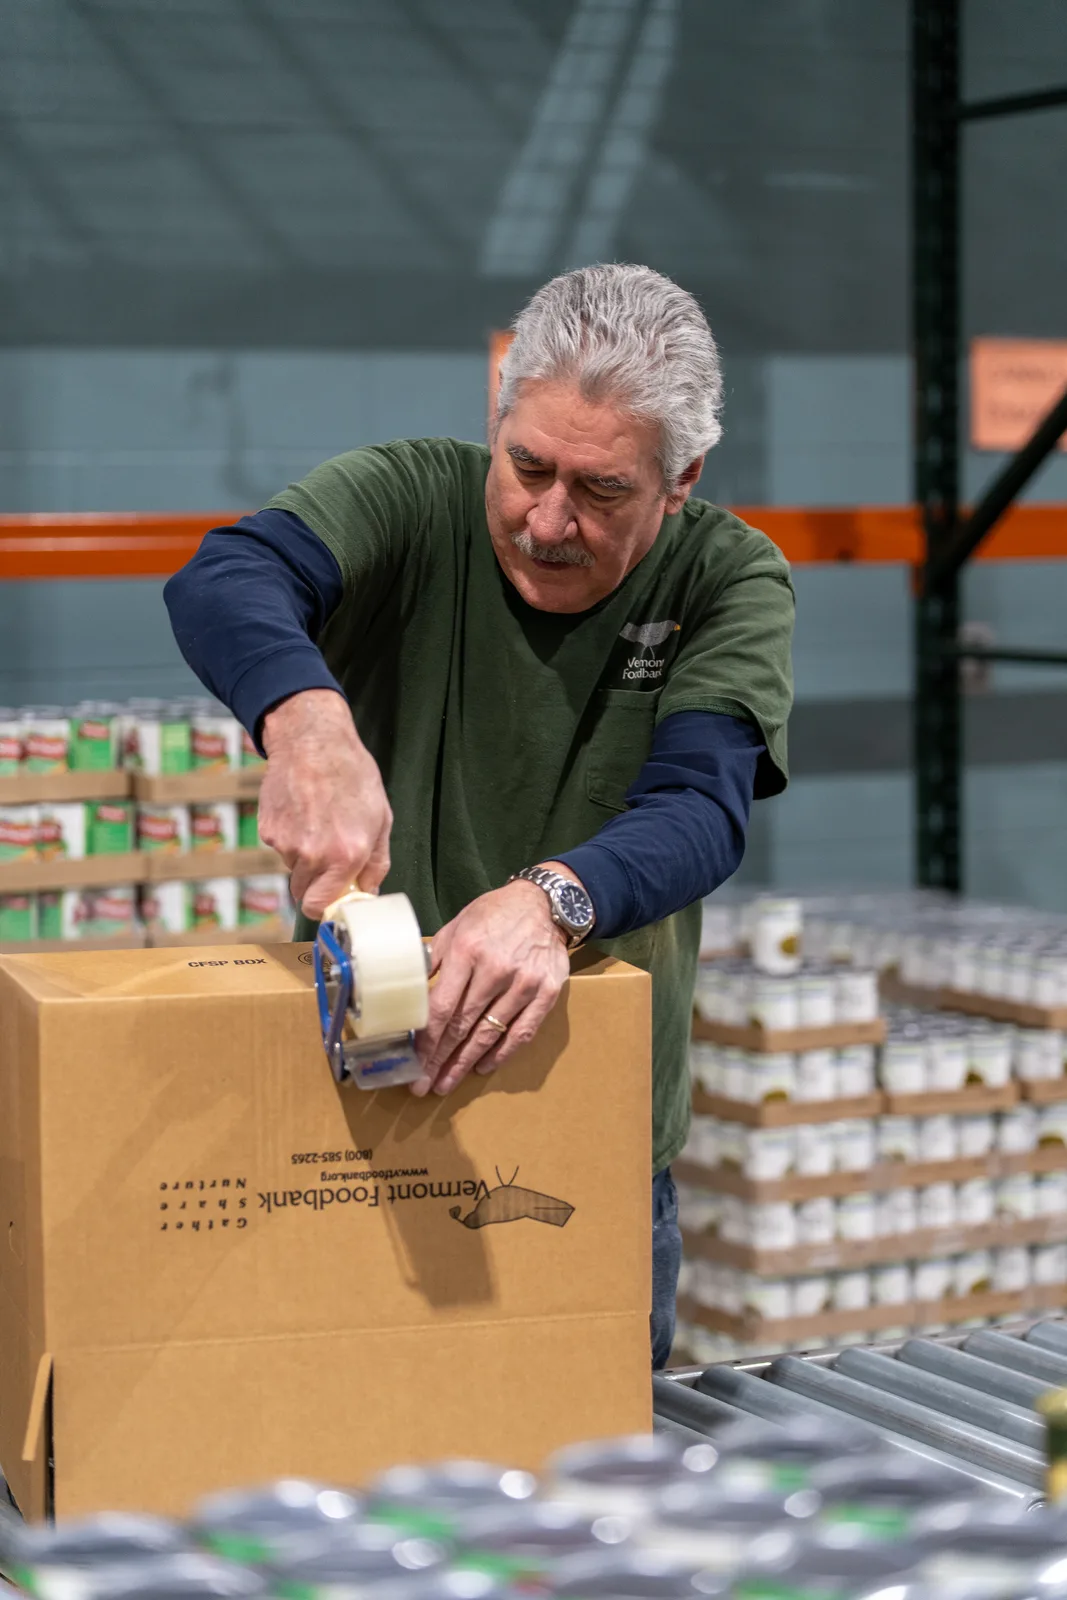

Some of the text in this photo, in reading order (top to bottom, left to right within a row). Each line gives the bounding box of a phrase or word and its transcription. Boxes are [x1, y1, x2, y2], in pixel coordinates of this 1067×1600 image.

[188, 958, 268, 968] CFSP BOX
[291, 1148, 373, 1164] (800) 585-2265
[320, 1167, 428, 1181] www.vtfoodbank.org
[159, 1177, 247, 1190] Nurture
[259, 1179, 491, 1213] Vermont Foodbank
[159, 1197, 247, 1210] Share
[160, 1217, 248, 1231] Gather
